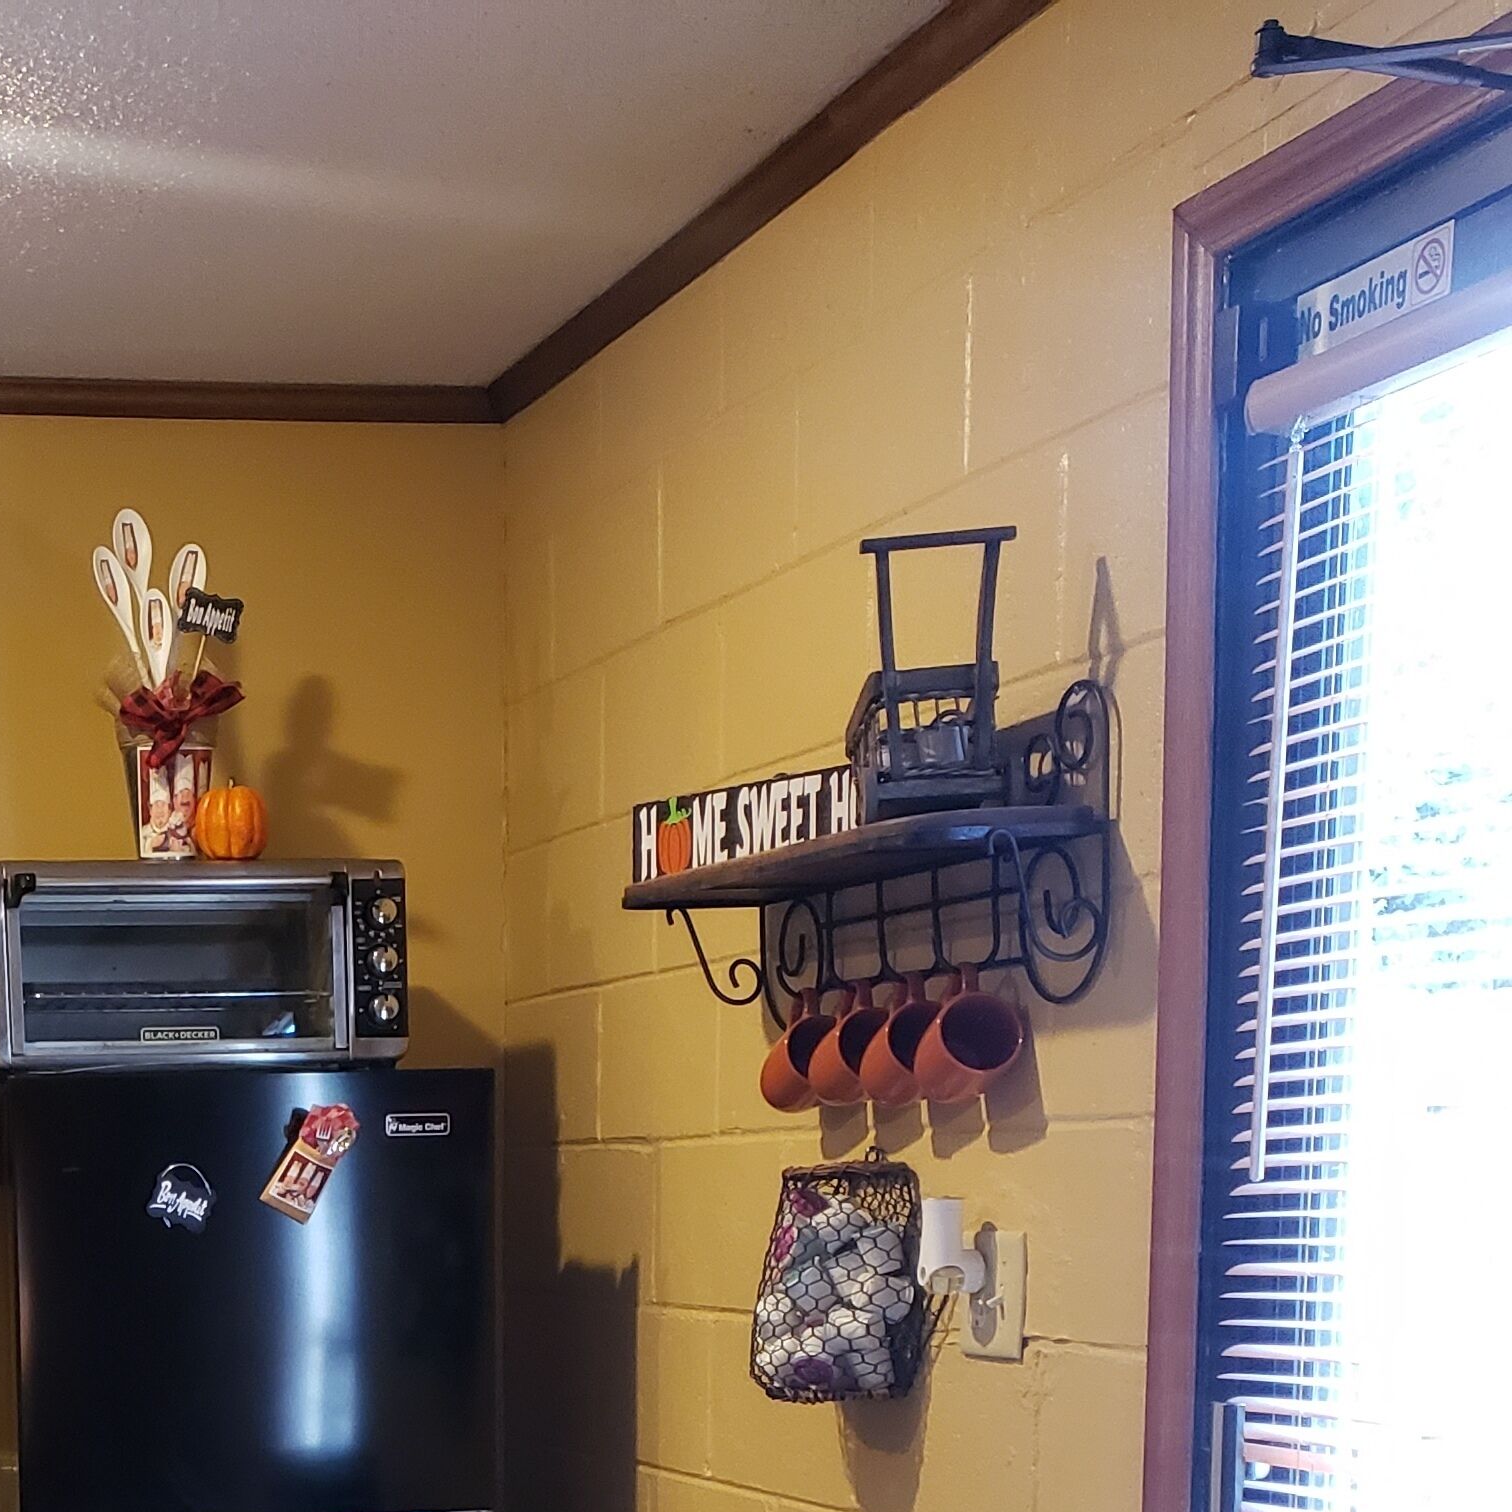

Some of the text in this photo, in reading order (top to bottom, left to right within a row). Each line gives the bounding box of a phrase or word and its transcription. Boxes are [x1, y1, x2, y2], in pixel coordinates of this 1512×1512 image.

[1299, 269, 1408, 343] No Smoking
[186, 598, 203, 625] Bon
[735, 774, 822, 859] SWEET
[399, 1122, 445, 1132] Magic Chef
[157, 1180, 177, 1204] Bon
